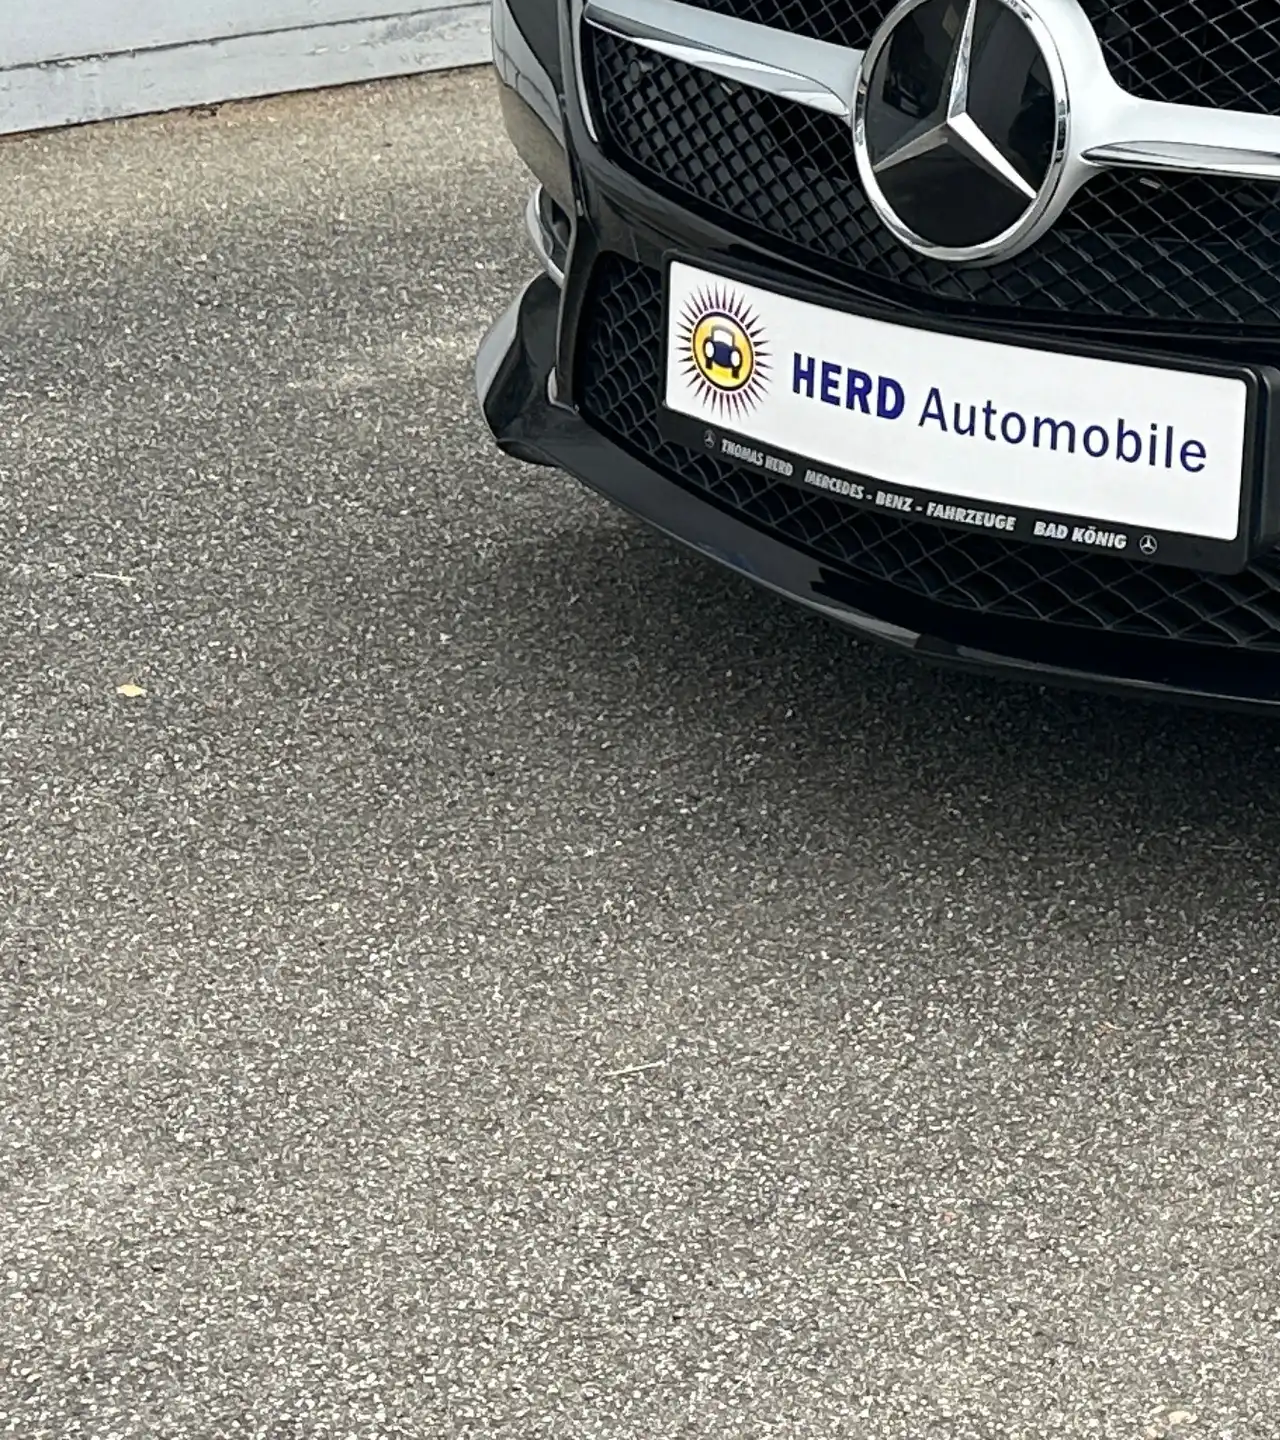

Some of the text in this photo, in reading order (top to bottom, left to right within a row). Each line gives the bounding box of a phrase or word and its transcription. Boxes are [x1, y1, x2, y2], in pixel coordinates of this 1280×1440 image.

[792, 351, 1207, 474] HERD Automobile
[721, 438, 764, 468] THOMAS
[764, 454, 794, 477] HERD
[803, 469, 865, 500] MERCEDES
[874, 490, 912, 512] BENZ
[926, 501, 1017, 531] FAHRZEUGE
[1033, 521, 1069, 540] BAD
[1071, 525, 1128, 550] KÖNIG
